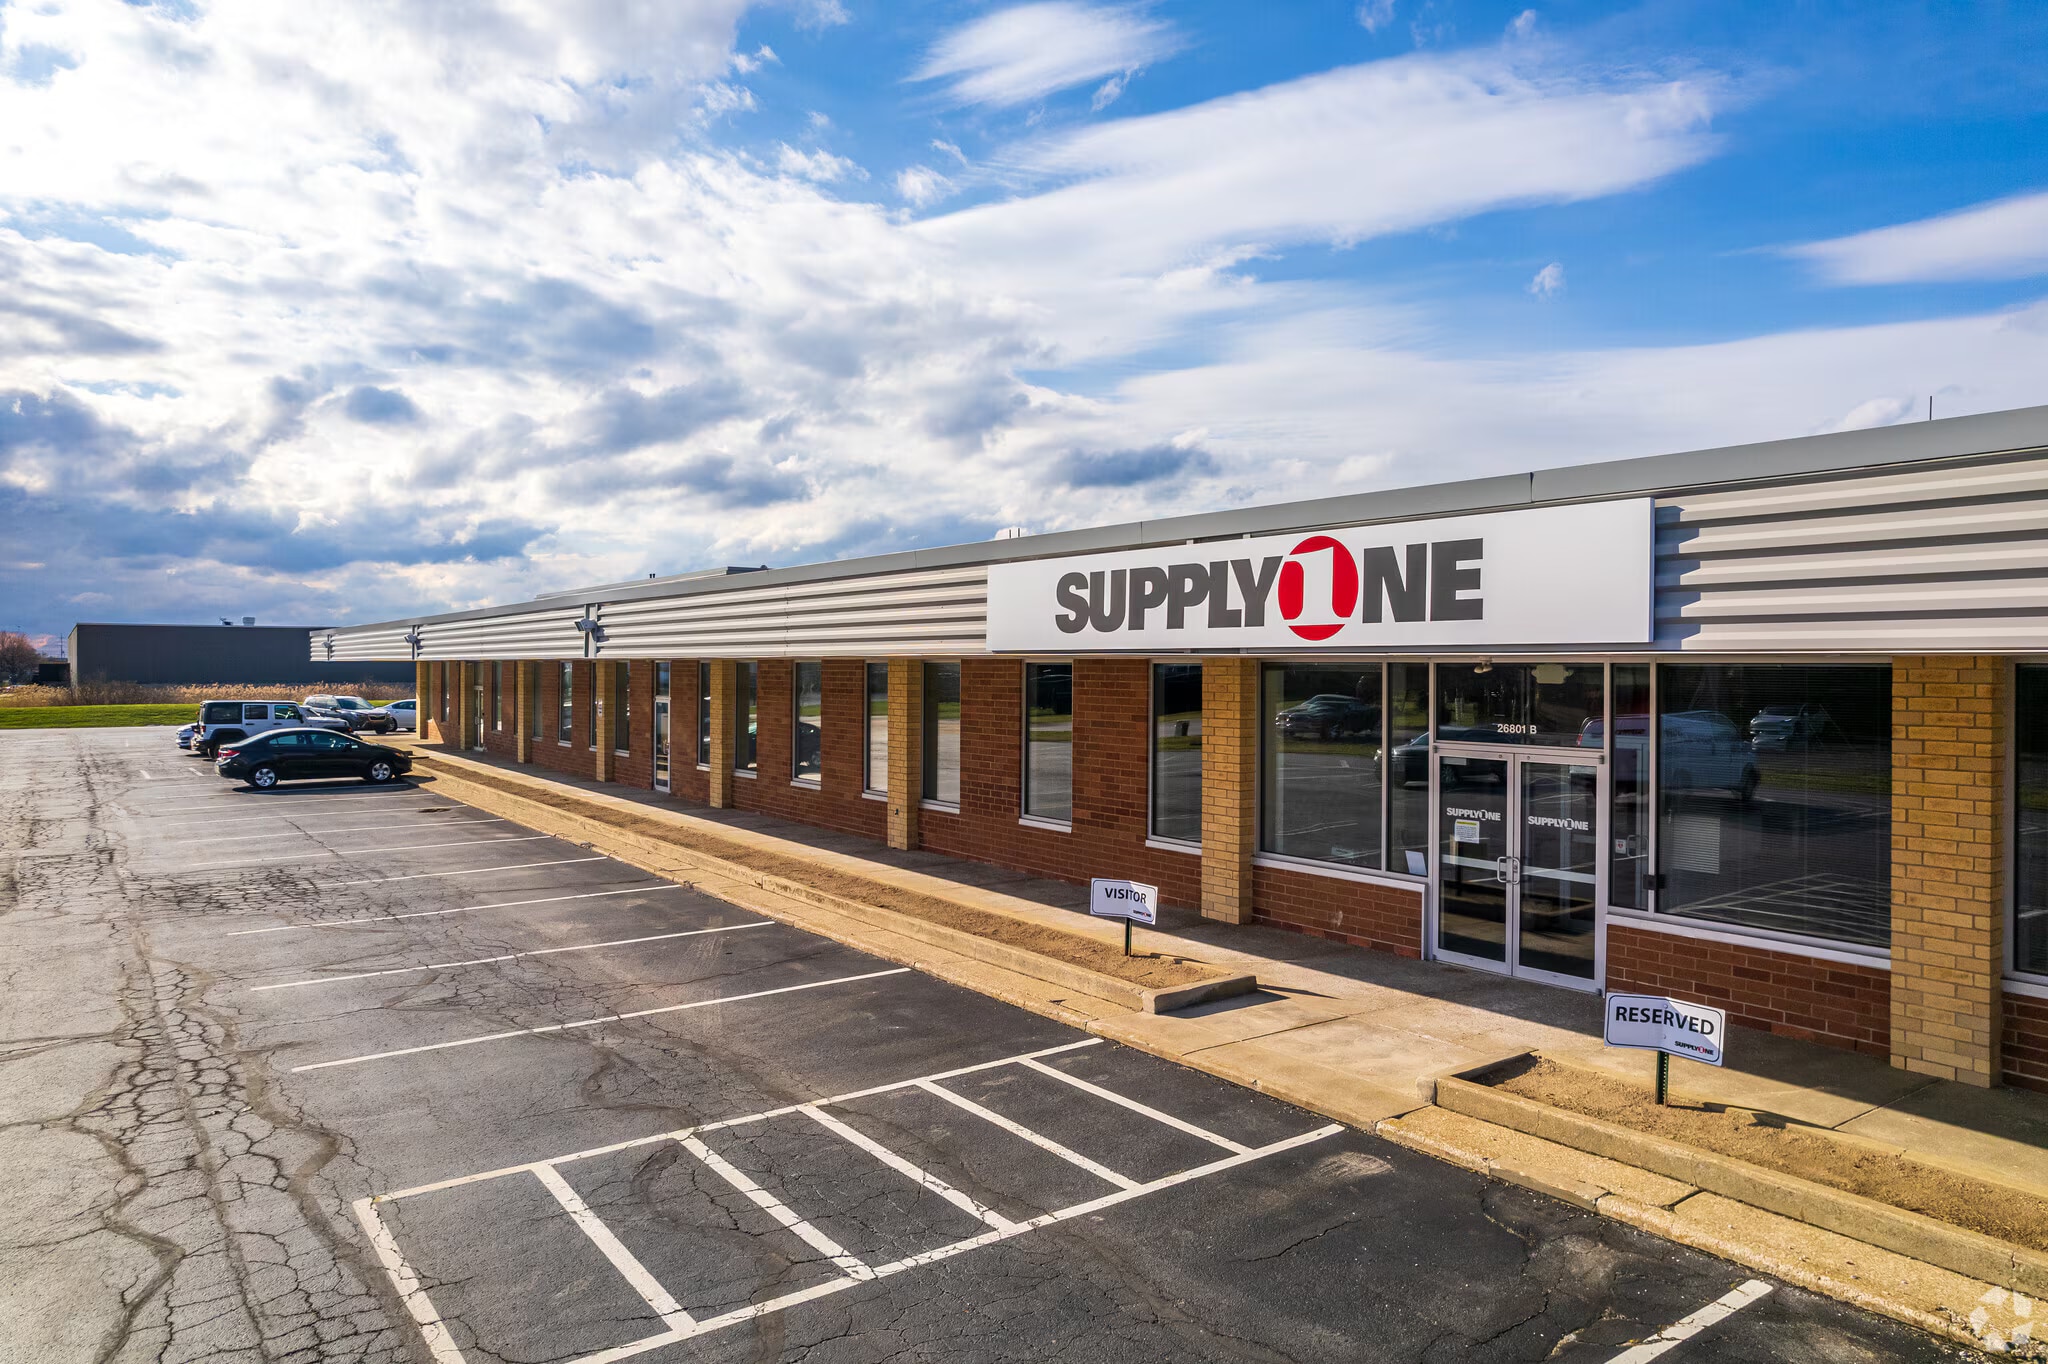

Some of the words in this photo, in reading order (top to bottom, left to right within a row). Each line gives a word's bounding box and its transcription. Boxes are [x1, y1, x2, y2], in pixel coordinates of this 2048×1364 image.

[1497, 723, 1526, 734] 26801
[1530, 725, 1537, 734] B
[1105, 888, 1146, 903] VISITOR
[1615, 1006, 1715, 1035] RESERVED
